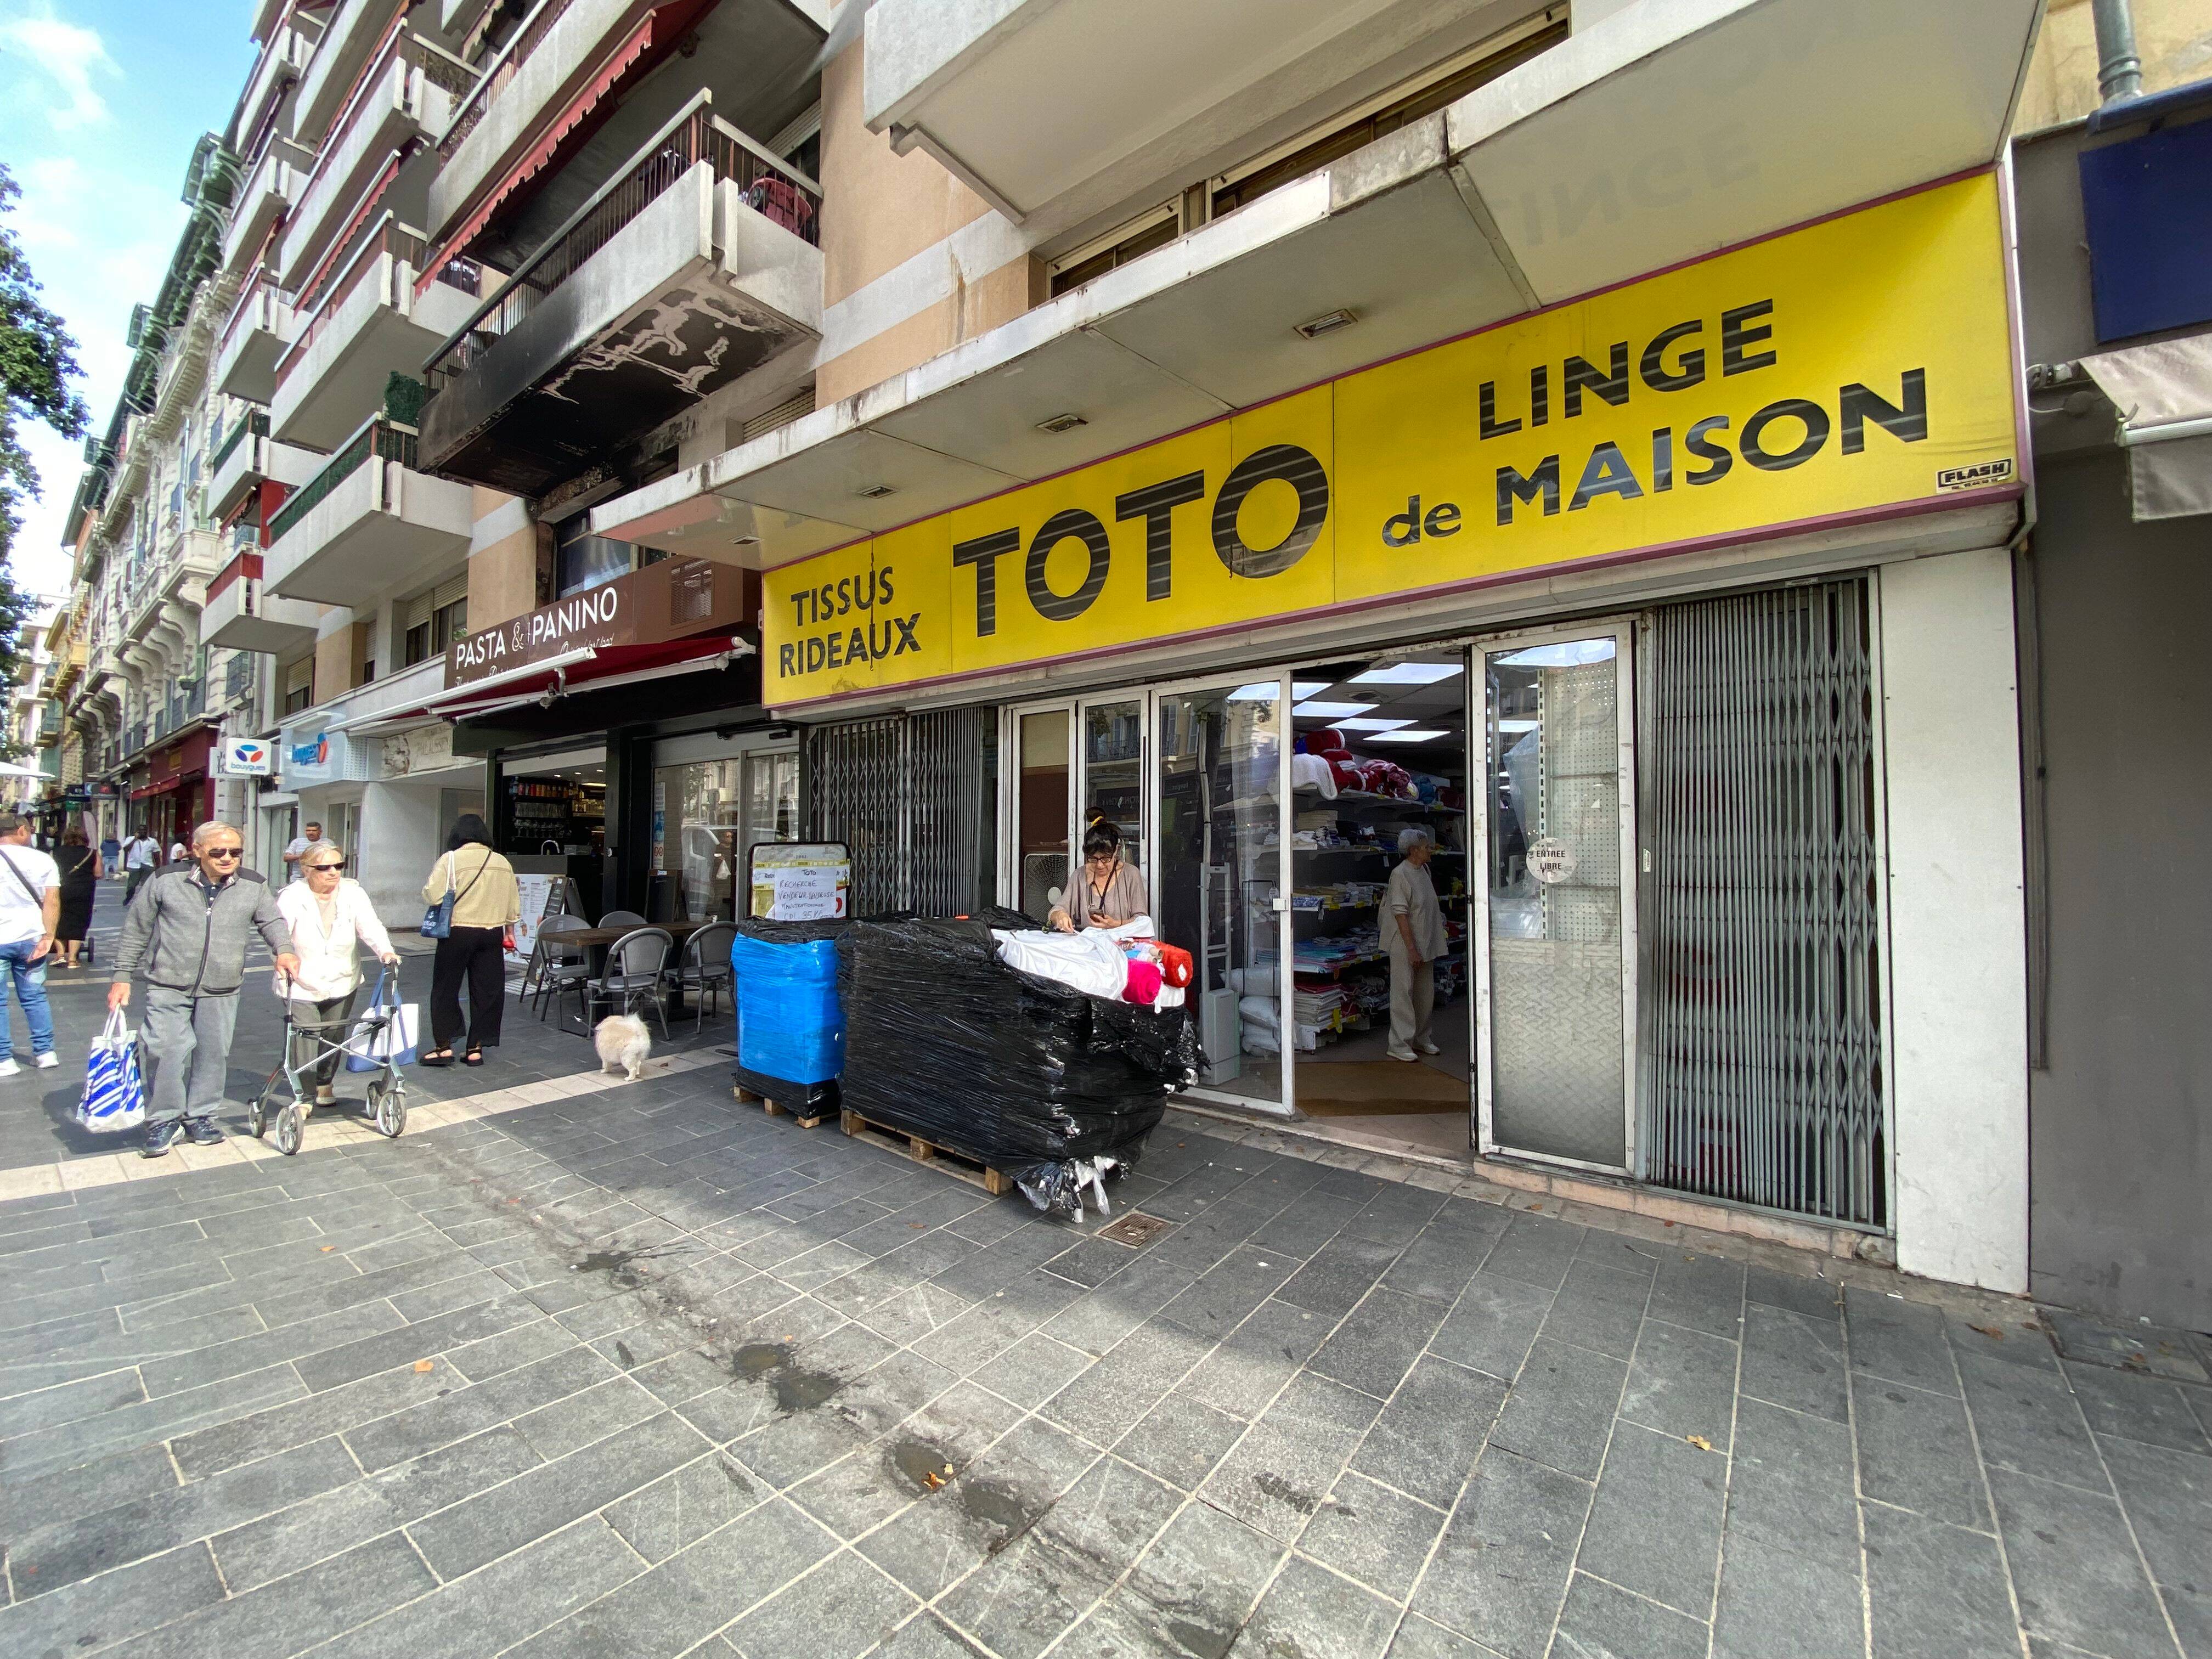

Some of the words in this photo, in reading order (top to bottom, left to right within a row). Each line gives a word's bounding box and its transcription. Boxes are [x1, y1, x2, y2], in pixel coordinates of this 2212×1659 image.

[1478, 298, 1778, 441] LINGE
[1381, 494, 1462, 548] de
[1496, 367, 1929, 527] MAISON
[1944, 463, 2005, 483] FLASH
[953, 443, 1329, 637] TOTO
[456, 629, 506, 670] PASTA
[511, 622, 524, 652] &
[532, 586, 618, 646] PANINO
[790, 565, 895, 627] TISSUS
[780, 612, 922, 678] RIDEAUX
[780, 879, 817, 888] RECHERCHE
